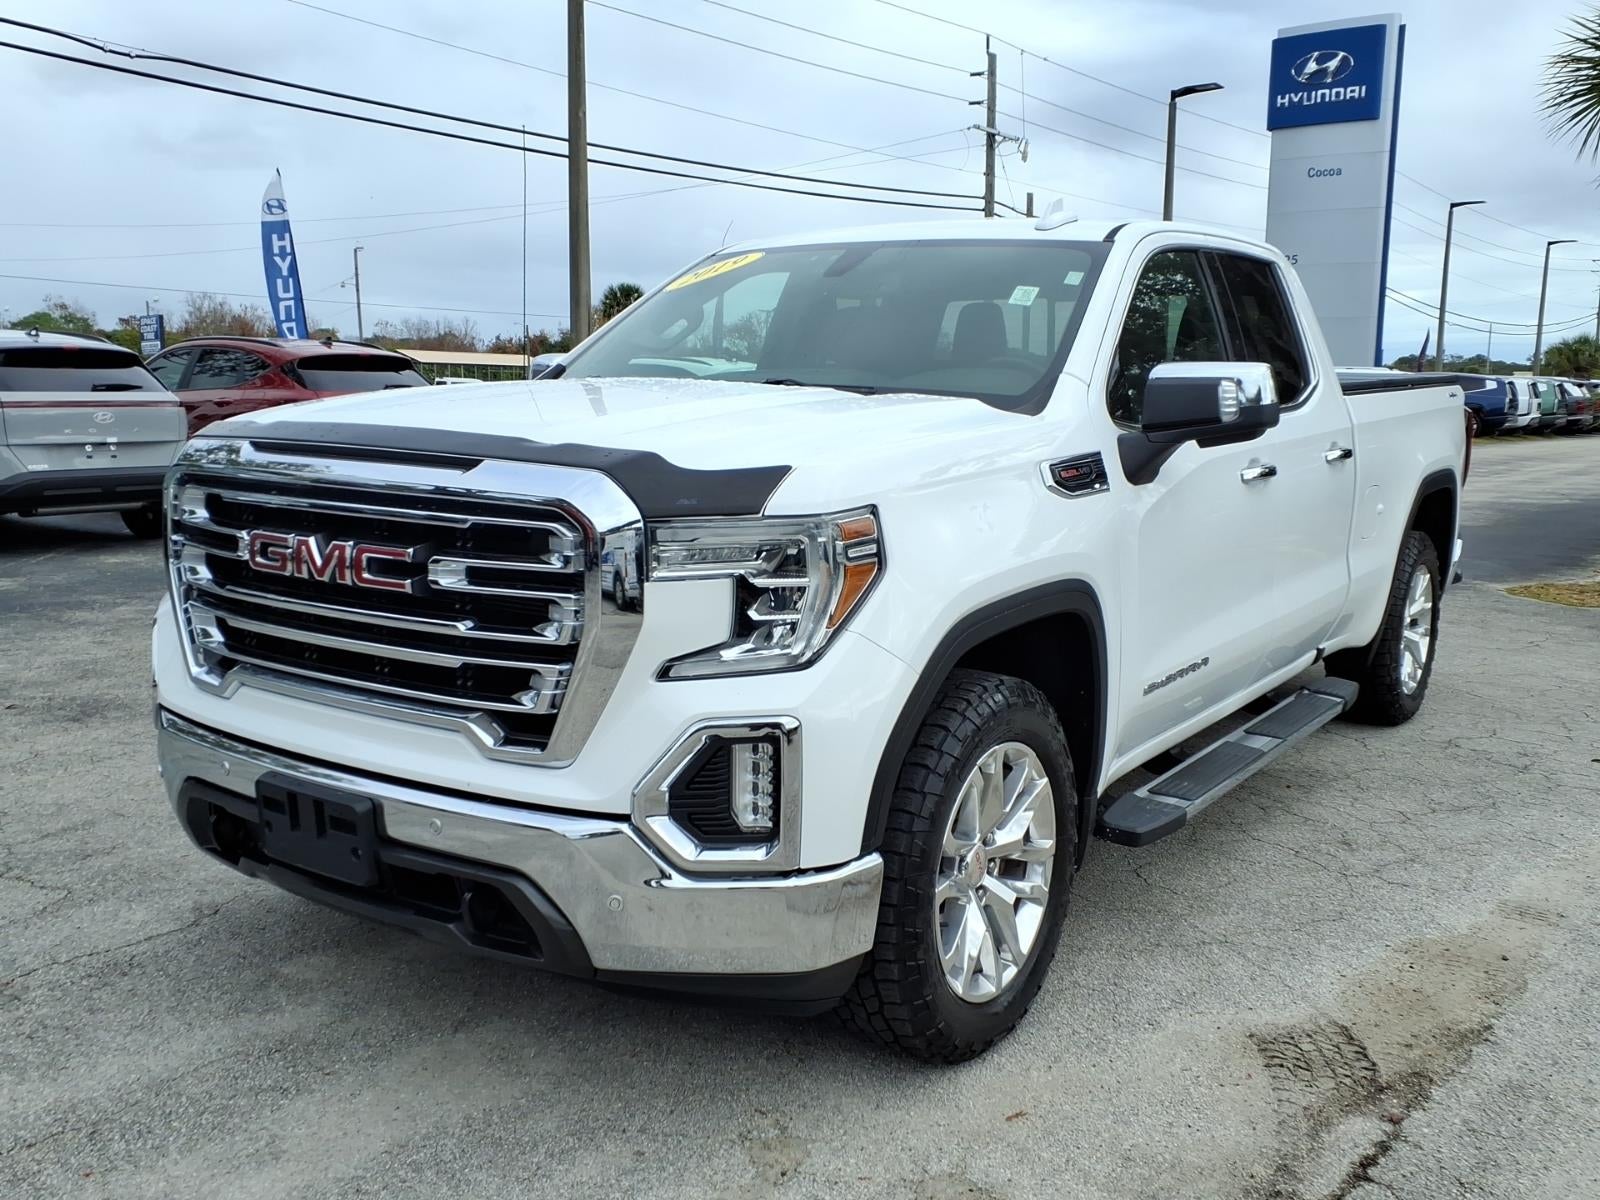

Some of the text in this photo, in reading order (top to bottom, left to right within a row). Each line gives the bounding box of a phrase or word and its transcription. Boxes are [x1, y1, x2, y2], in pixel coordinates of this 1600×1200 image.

[1276, 85, 1367, 108] HYUNDAI
[1307, 167, 1343, 178] Cocoa
[140, 325, 158, 333] COAST
[248, 530, 414, 594] GMC
